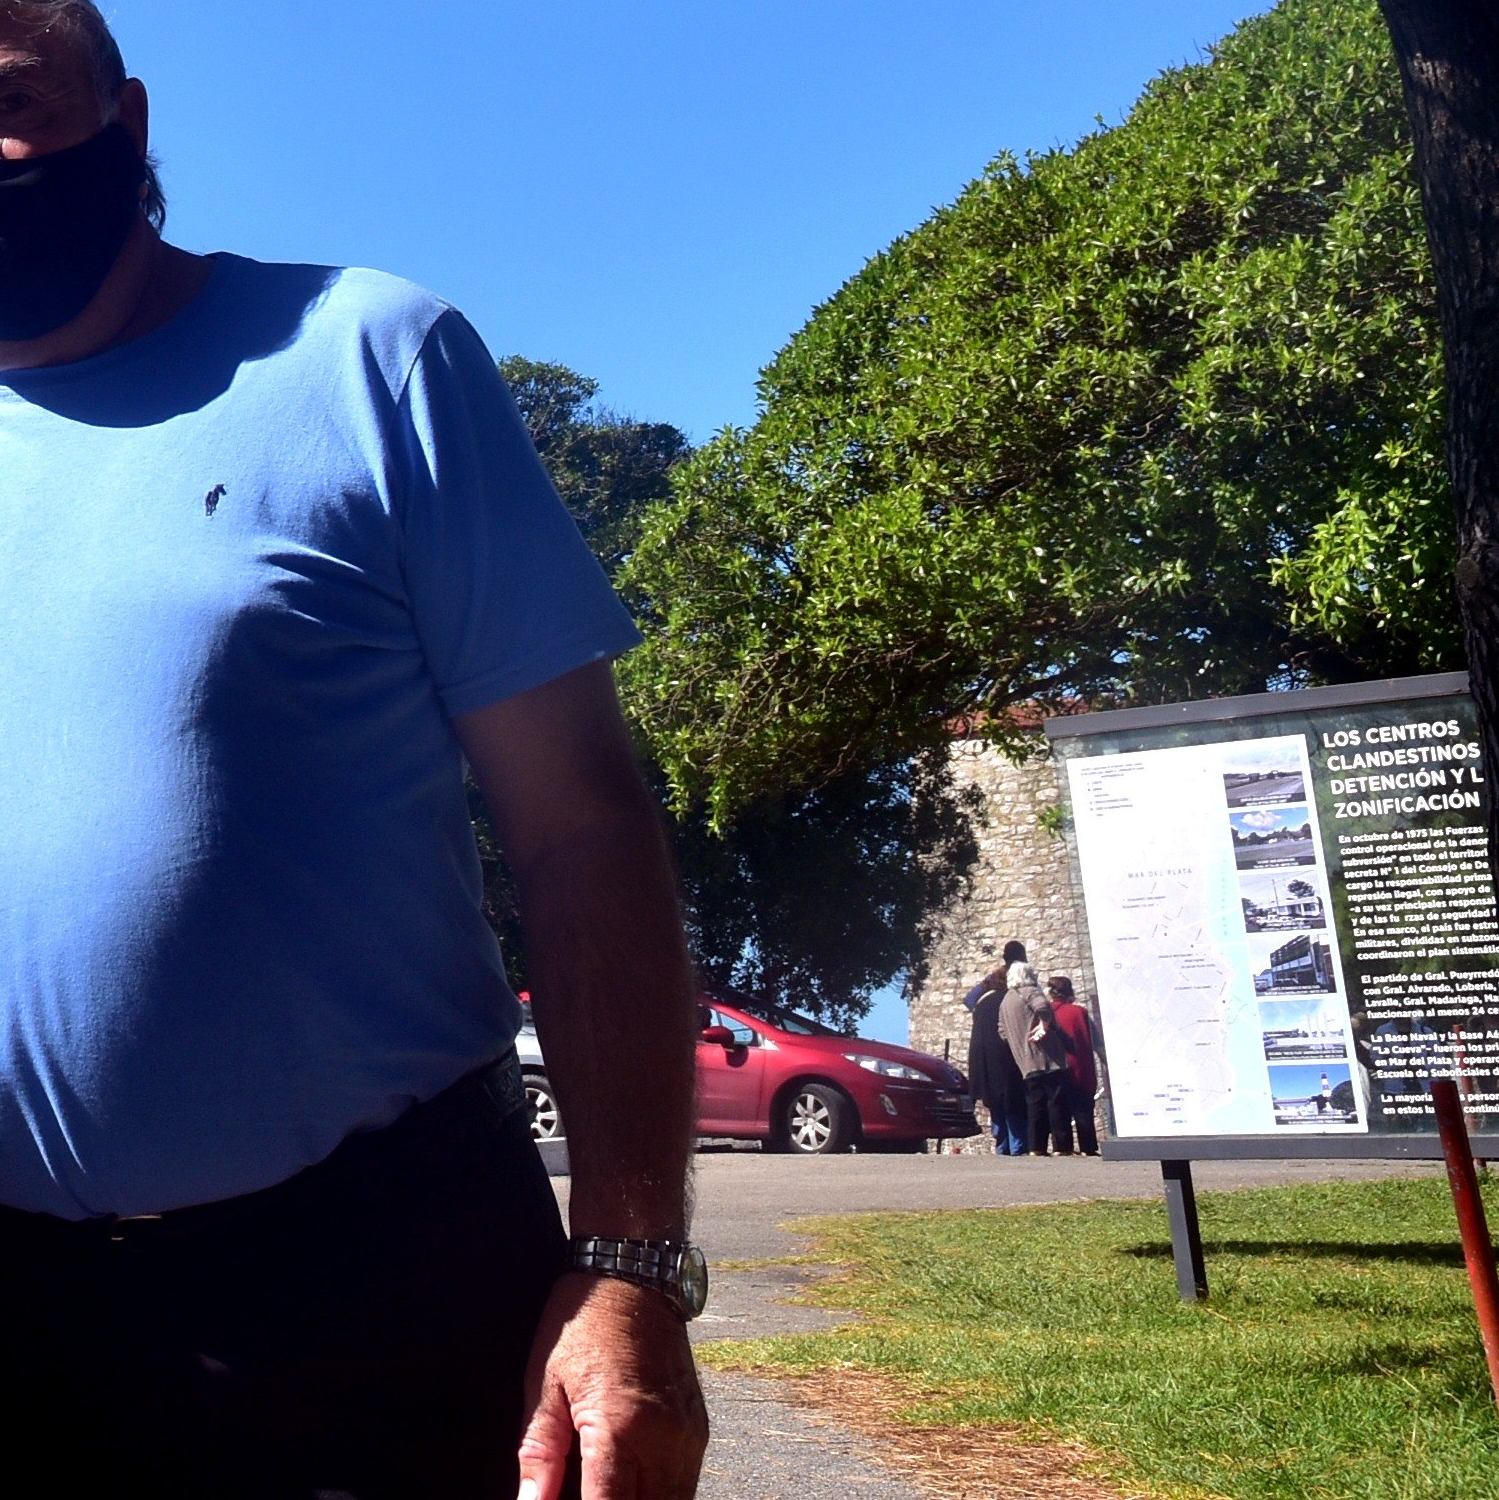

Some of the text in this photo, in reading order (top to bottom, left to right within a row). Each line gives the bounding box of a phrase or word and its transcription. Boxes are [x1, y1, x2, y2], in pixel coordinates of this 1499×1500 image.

[1323, 720, 1460, 748] LOS CENTROS
[1327, 743, 1481, 771] CLANDESTINOS
[1330, 767, 1446, 794] DETENCIÓN
[1450, 768, 1464, 784] Y
[1333, 789, 1481, 818] ZONIFICACIÓN
[1338, 826, 1483, 844] En octubre de 1975 las Fuerzas
[1340, 839, 1457, 855] control operacional de la
[1399, 851, 1448, 863] en todo el
[1344, 861, 1472, 878] secreta del Consejo de
[1346, 874, 1462, 891] cargo la responsabilidad
[1348, 889, 1392, 902] represión
[1425, 888, 1443, 896] con
[1446, 886, 1475, 897] apoyo
[1478, 883, 1490, 893] de
[1363, 899, 1447, 912] su vez principales
[1351, 917, 1357, 926] y
[1360, 914, 1372, 924] de
[1374, 914, 1388, 923] las
[1426, 911, 1439, 920] de
[1441, 908, 1490, 921] seguridad
[1353, 926, 1366, 936] En
[1386, 926, 1419, 936] marco,
[1421, 923, 1430, 932] el
[1432, 922, 1452, 934] país
[1454, 921, 1470, 931] fue
[1355, 937, 1399, 950] militares,
[1401, 935, 1445, 946] divididas
[1357, 947, 1450, 960] coordinaron el plan
[1361, 971, 1448, 985] El partido de Gral.
[1383, 985, 1405, 995] Gral.
[1408, 983, 1454, 996] Alvarado,
[1365, 994, 1482, 1009] Lavalle, Gral. Madariaga,
[1367, 1006, 1485, 1019] funcionaron al menos 24
[1371, 1030, 1483, 1043] La Base Naval y la Base
[1433, 1042, 1483, 1053] fueron los
[1389, 1057, 1407, 1066] Mar
[1409, 1056, 1425, 1065] del
[1427, 1056, 1453, 1065] Plata
[1453, 1057, 1460, 1066] y
[1377, 1069, 1414, 1079] Escuela
[1416, 1069, 1428, 1078] de
[1381, 1093, 1393, 1103] La
[1397, 1105, 1423, 1114] estos
